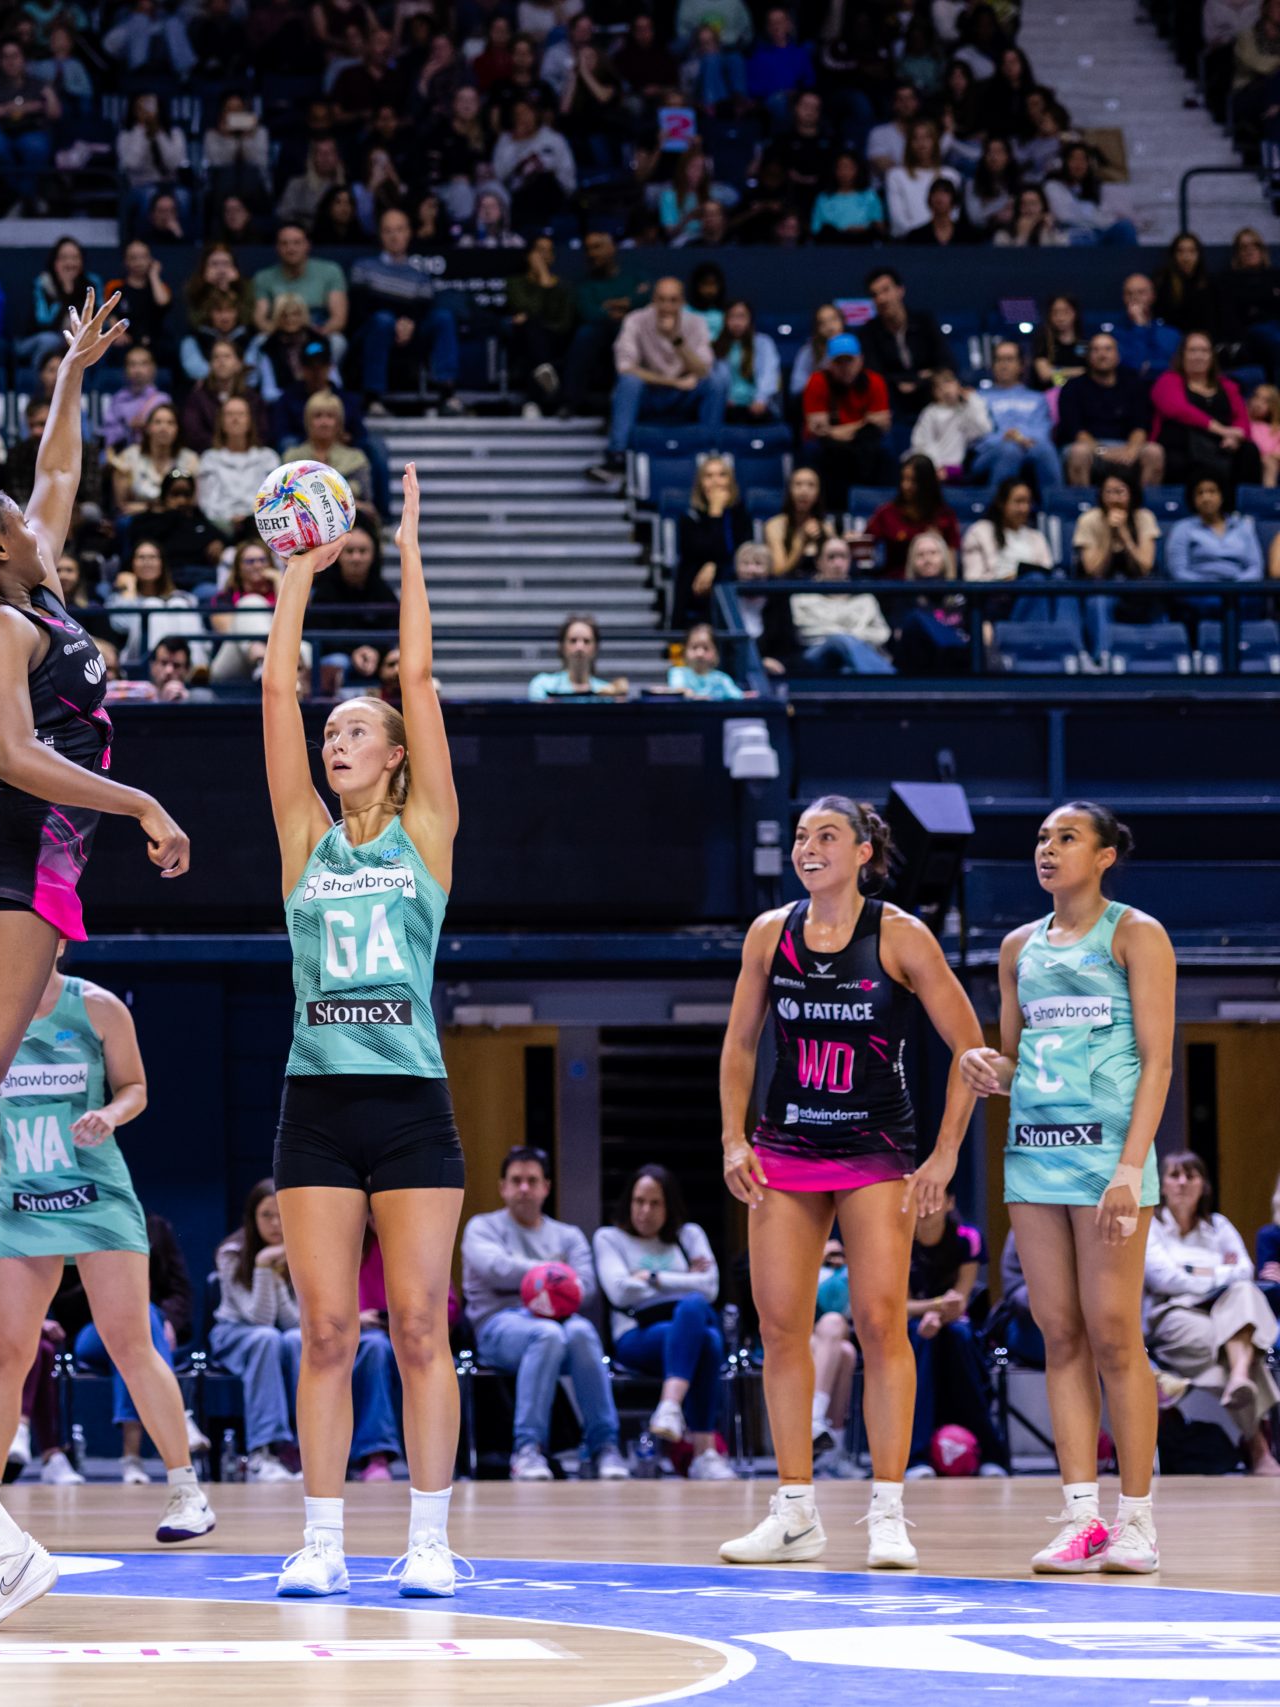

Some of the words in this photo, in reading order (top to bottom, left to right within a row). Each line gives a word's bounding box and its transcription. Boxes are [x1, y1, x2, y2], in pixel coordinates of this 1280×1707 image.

[320, 494, 336, 542] NETBALL
[322, 873, 415, 892] shawbrook
[323, 904, 405, 978] GA
[836, 981, 880, 991] PULE
[315, 1002, 404, 1024] StoneX
[803, 1002, 874, 1021] FATFACE
[1033, 1003, 1109, 1022] shawbrook
[797, 1038, 854, 1094] WD
[1035, 1034, 1064, 1093] C
[4, 1072, 86, 1089] shawbrook
[800, 1107, 869, 1121] edwindoran
[6, 1116, 72, 1174] WA
[1020, 1125, 1094, 1146] StoneX
[19, 1187, 91, 1212] StoneX
